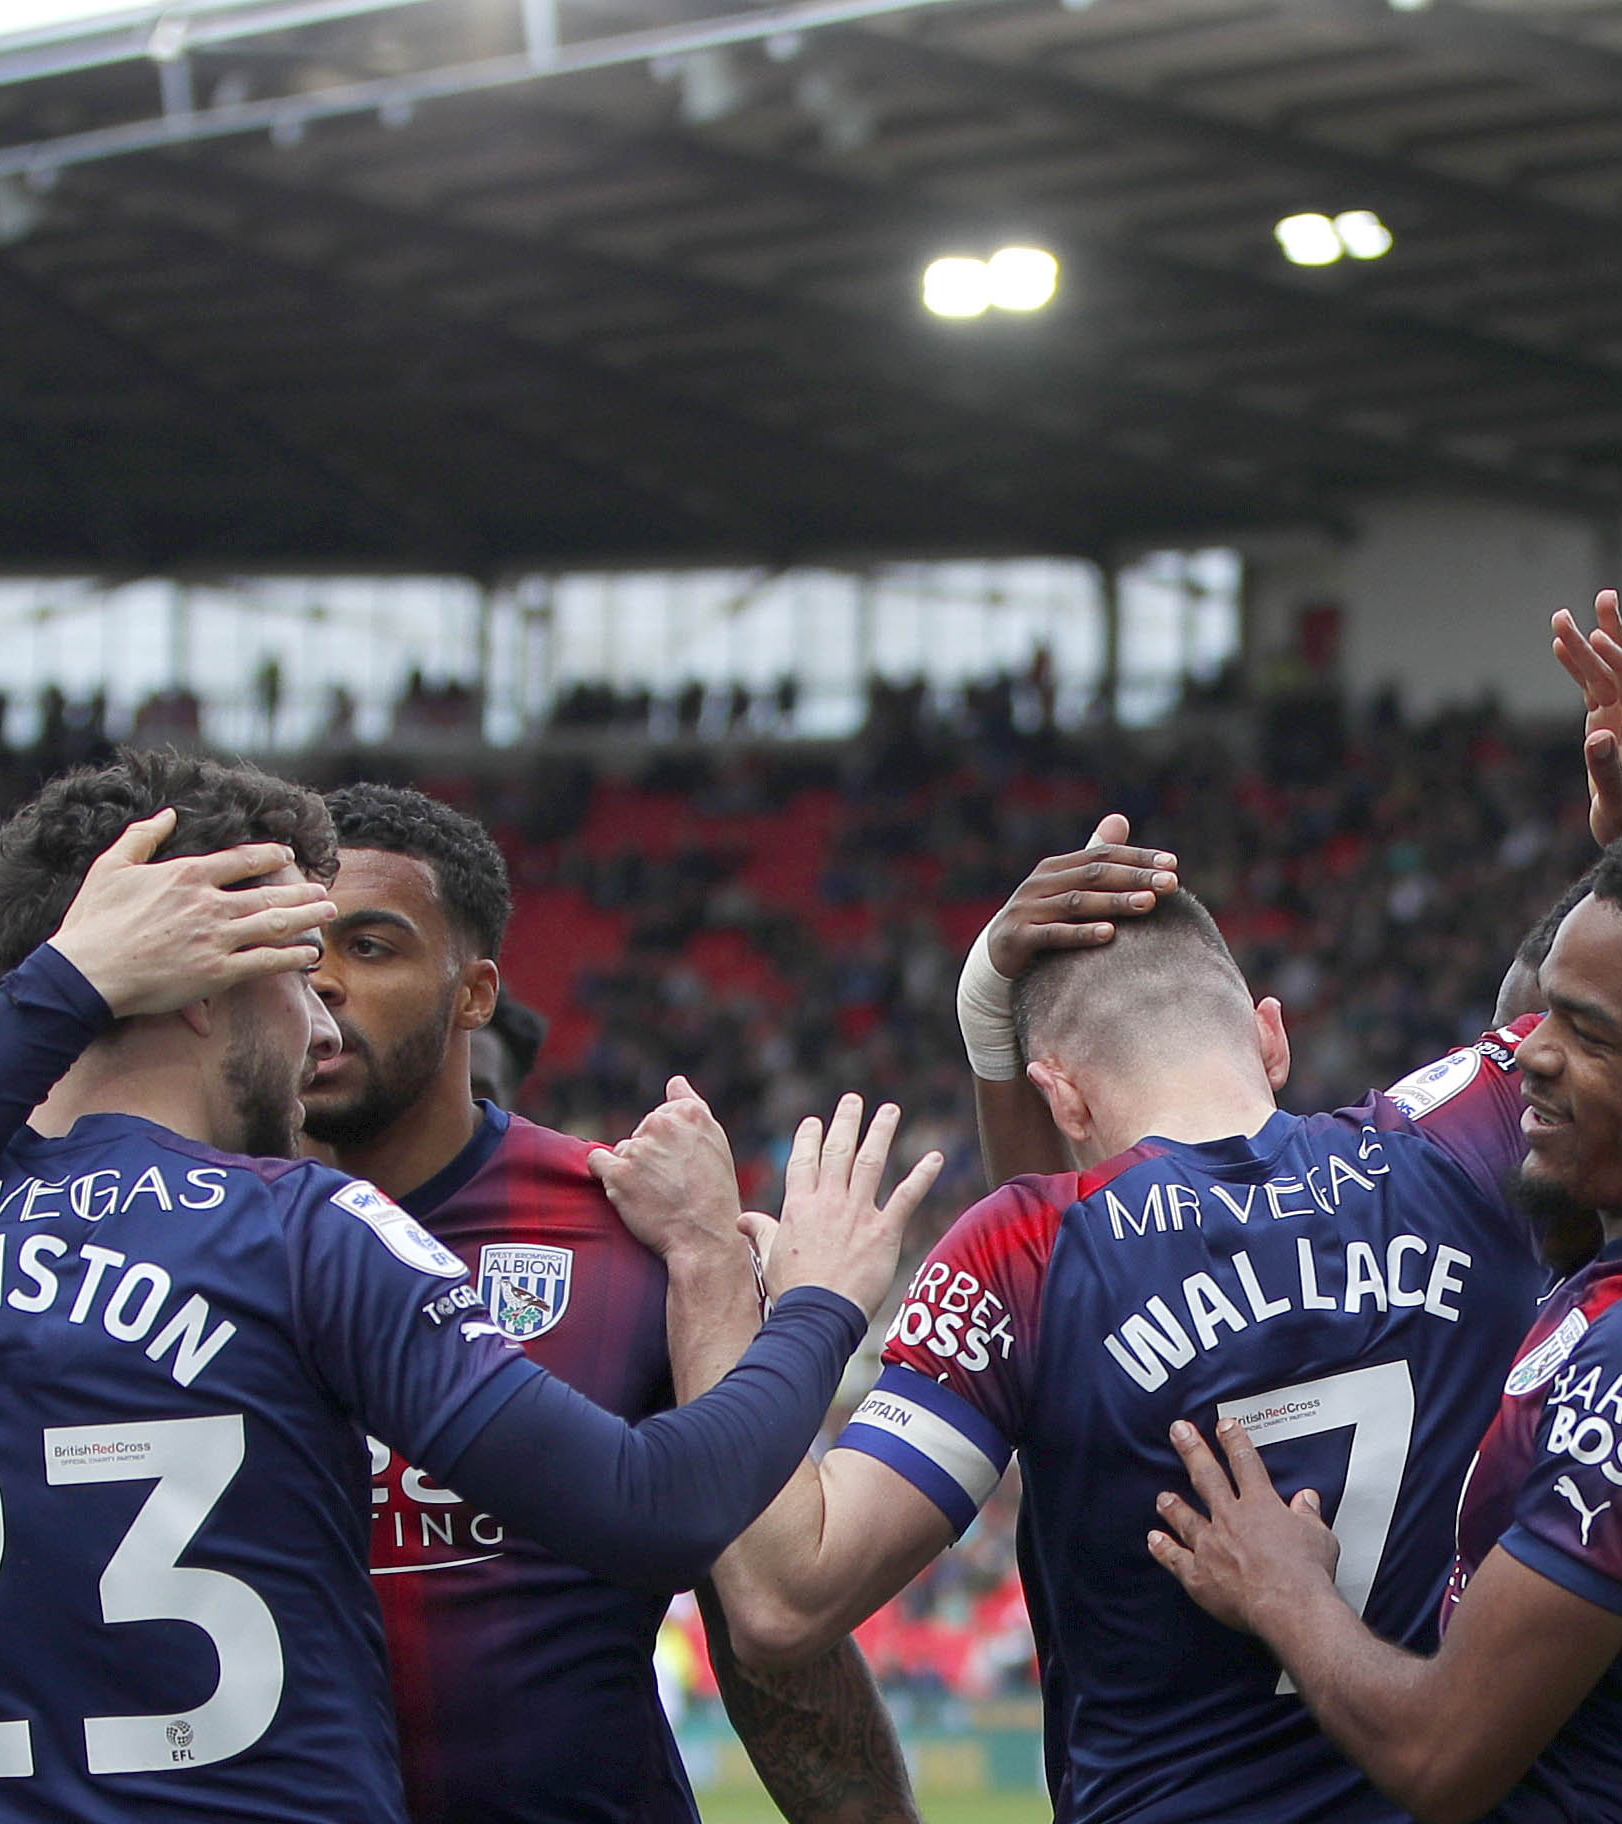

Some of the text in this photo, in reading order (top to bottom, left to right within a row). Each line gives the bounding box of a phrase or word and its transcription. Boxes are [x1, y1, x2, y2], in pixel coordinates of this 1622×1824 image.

[1105, 1183, 1201, 1241] MR
[489, 1251, 564, 1262] WEST BROMWICH
[487, 1259, 563, 1277] ALBION
[1103, 1235, 1473, 1393] WALLACE
[857, 1398, 913, 1427] APTAIN
[1234, 1399, 1322, 1425] ritishRedCross
[54, 1442, 151, 1457] BritishRedCross
[172, 1750, 196, 1761] EFL
